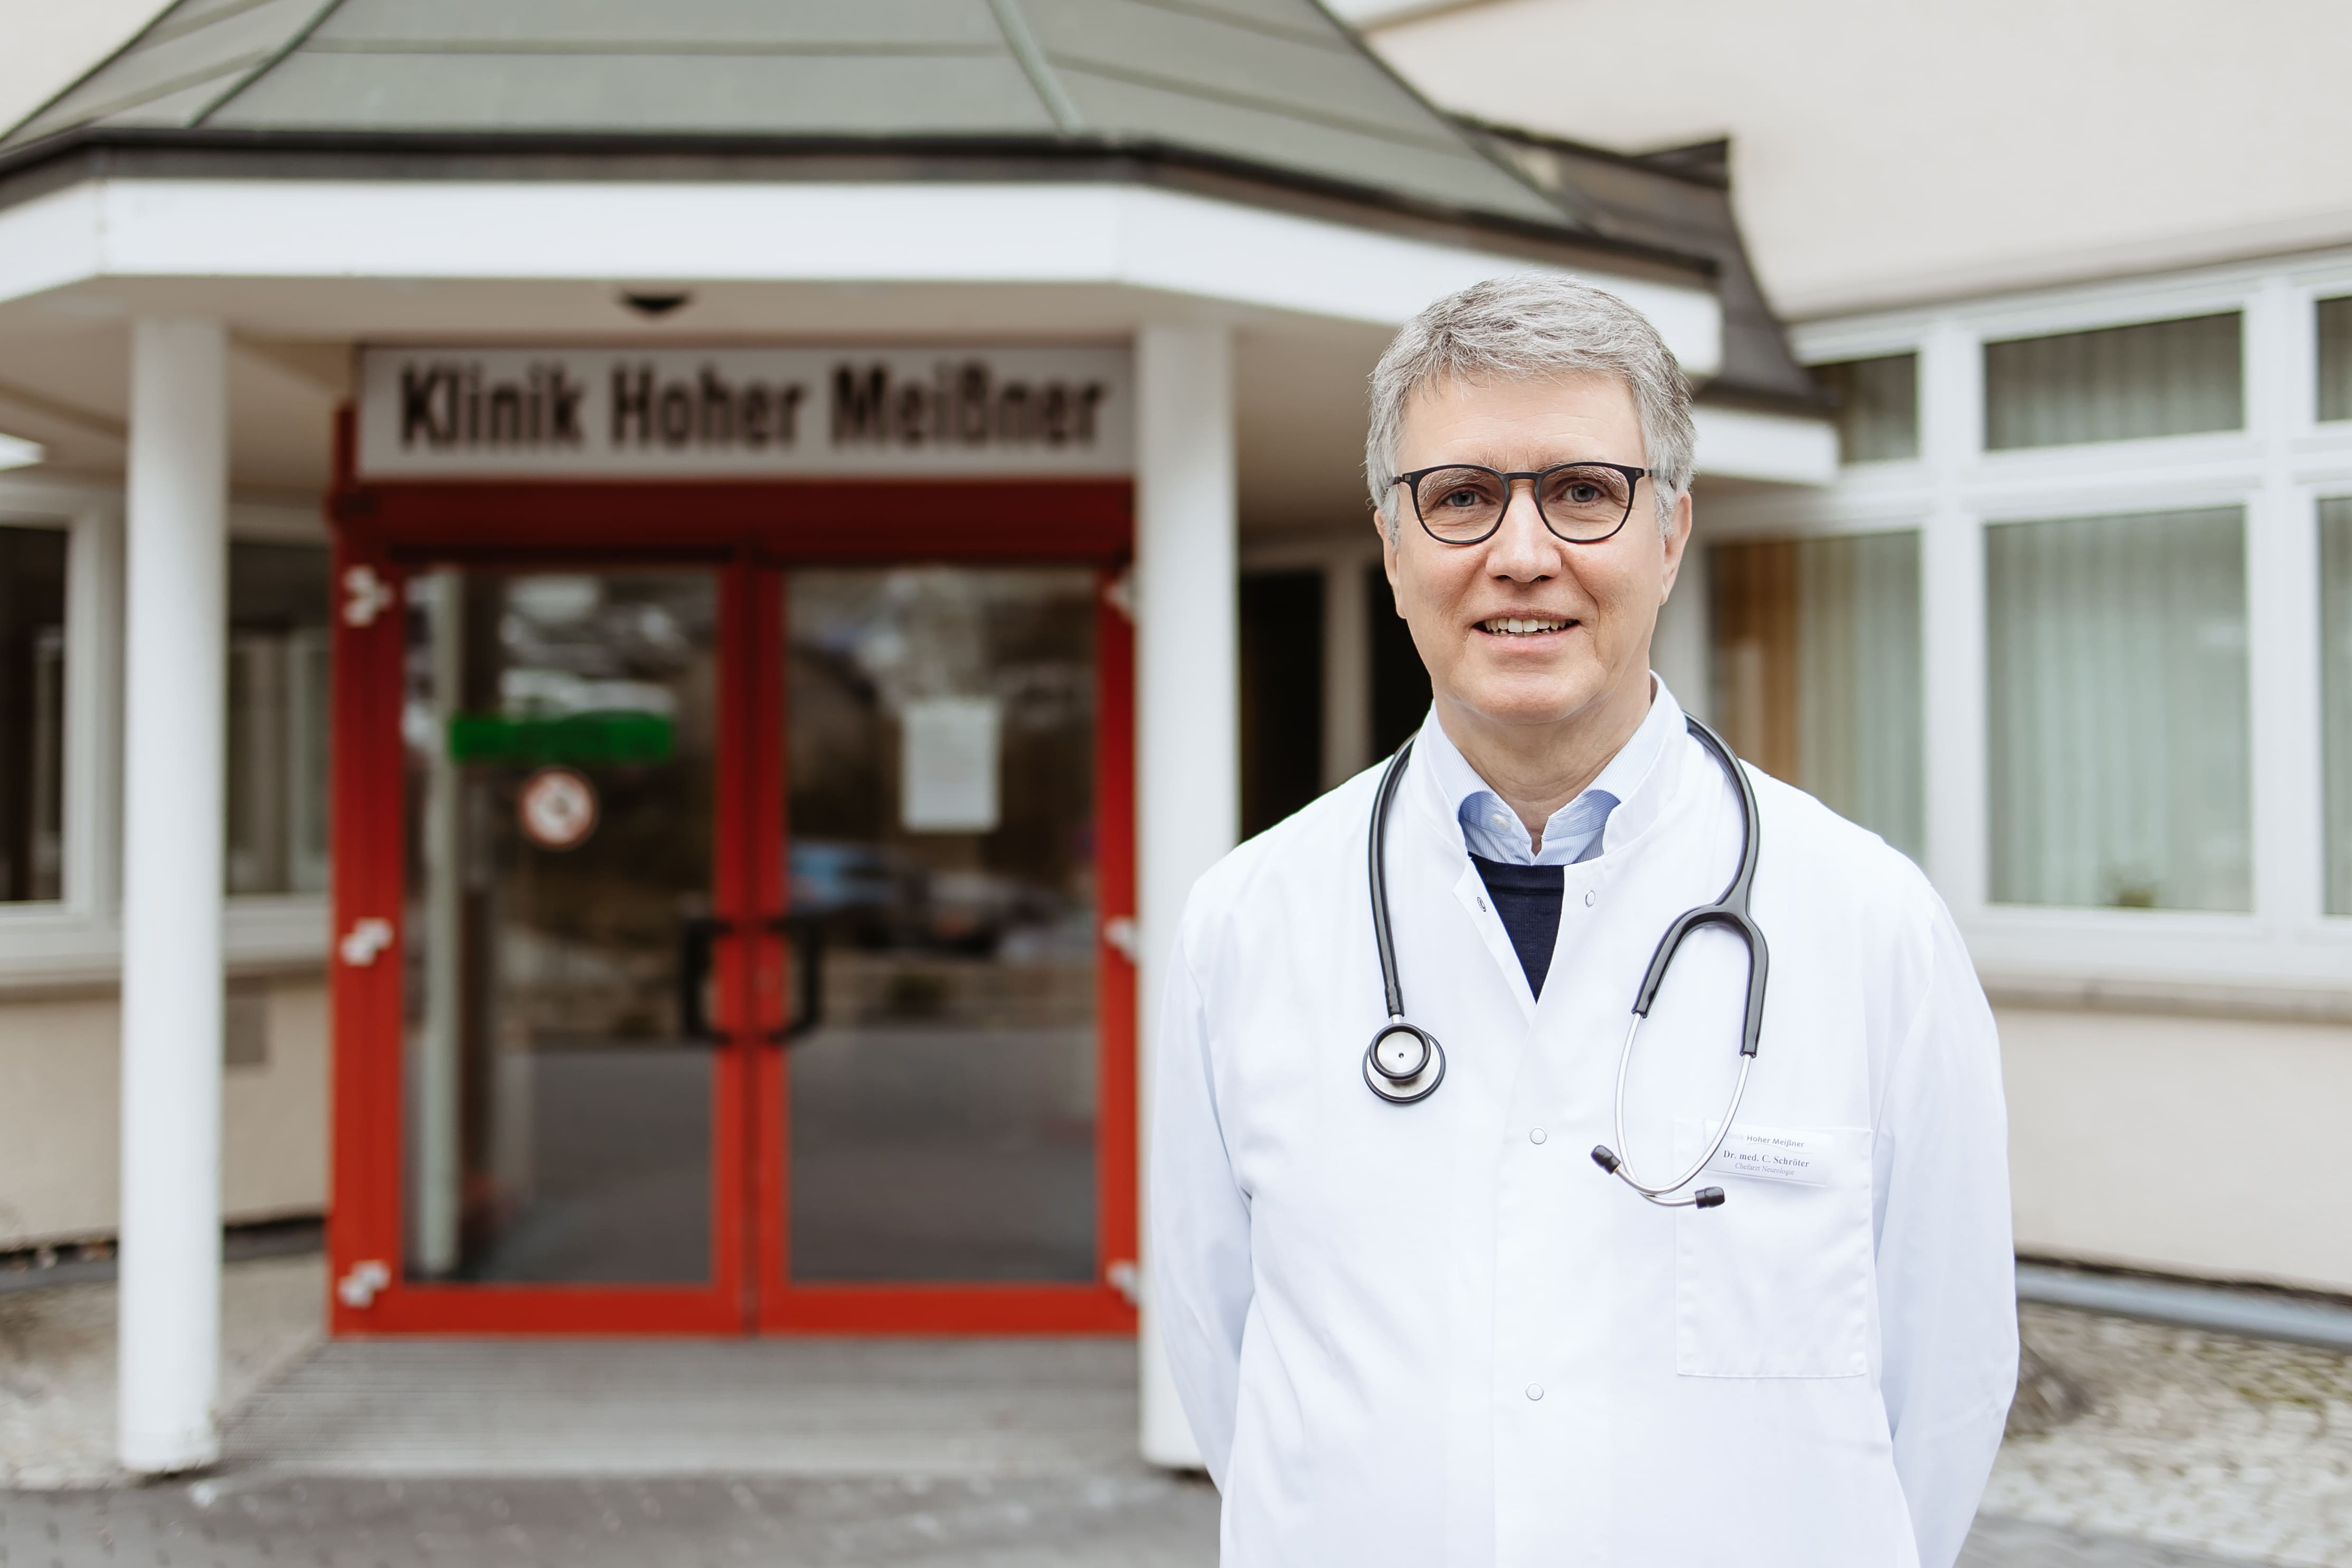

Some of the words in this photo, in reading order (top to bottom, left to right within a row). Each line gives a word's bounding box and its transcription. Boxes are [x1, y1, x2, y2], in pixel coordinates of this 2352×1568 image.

[400, 361, 584, 450] Klinik
[609, 361, 806, 450] Hoher
[829, 359, 1110, 450] Meißner
[1746, 1135, 1771, 1144] Hoher
[1772, 1138, 1805, 1147] Meißner
[1723, 1150, 1736, 1159] Dr.
[1739, 1153, 1759, 1162] med.
[1762, 1154, 1771, 1163] C.
[1773, 1156, 1810, 1168] Schröter
[1735, 1162, 1760, 1172] Chefarzt
[1762, 1165, 1795, 1176] Neurologie
